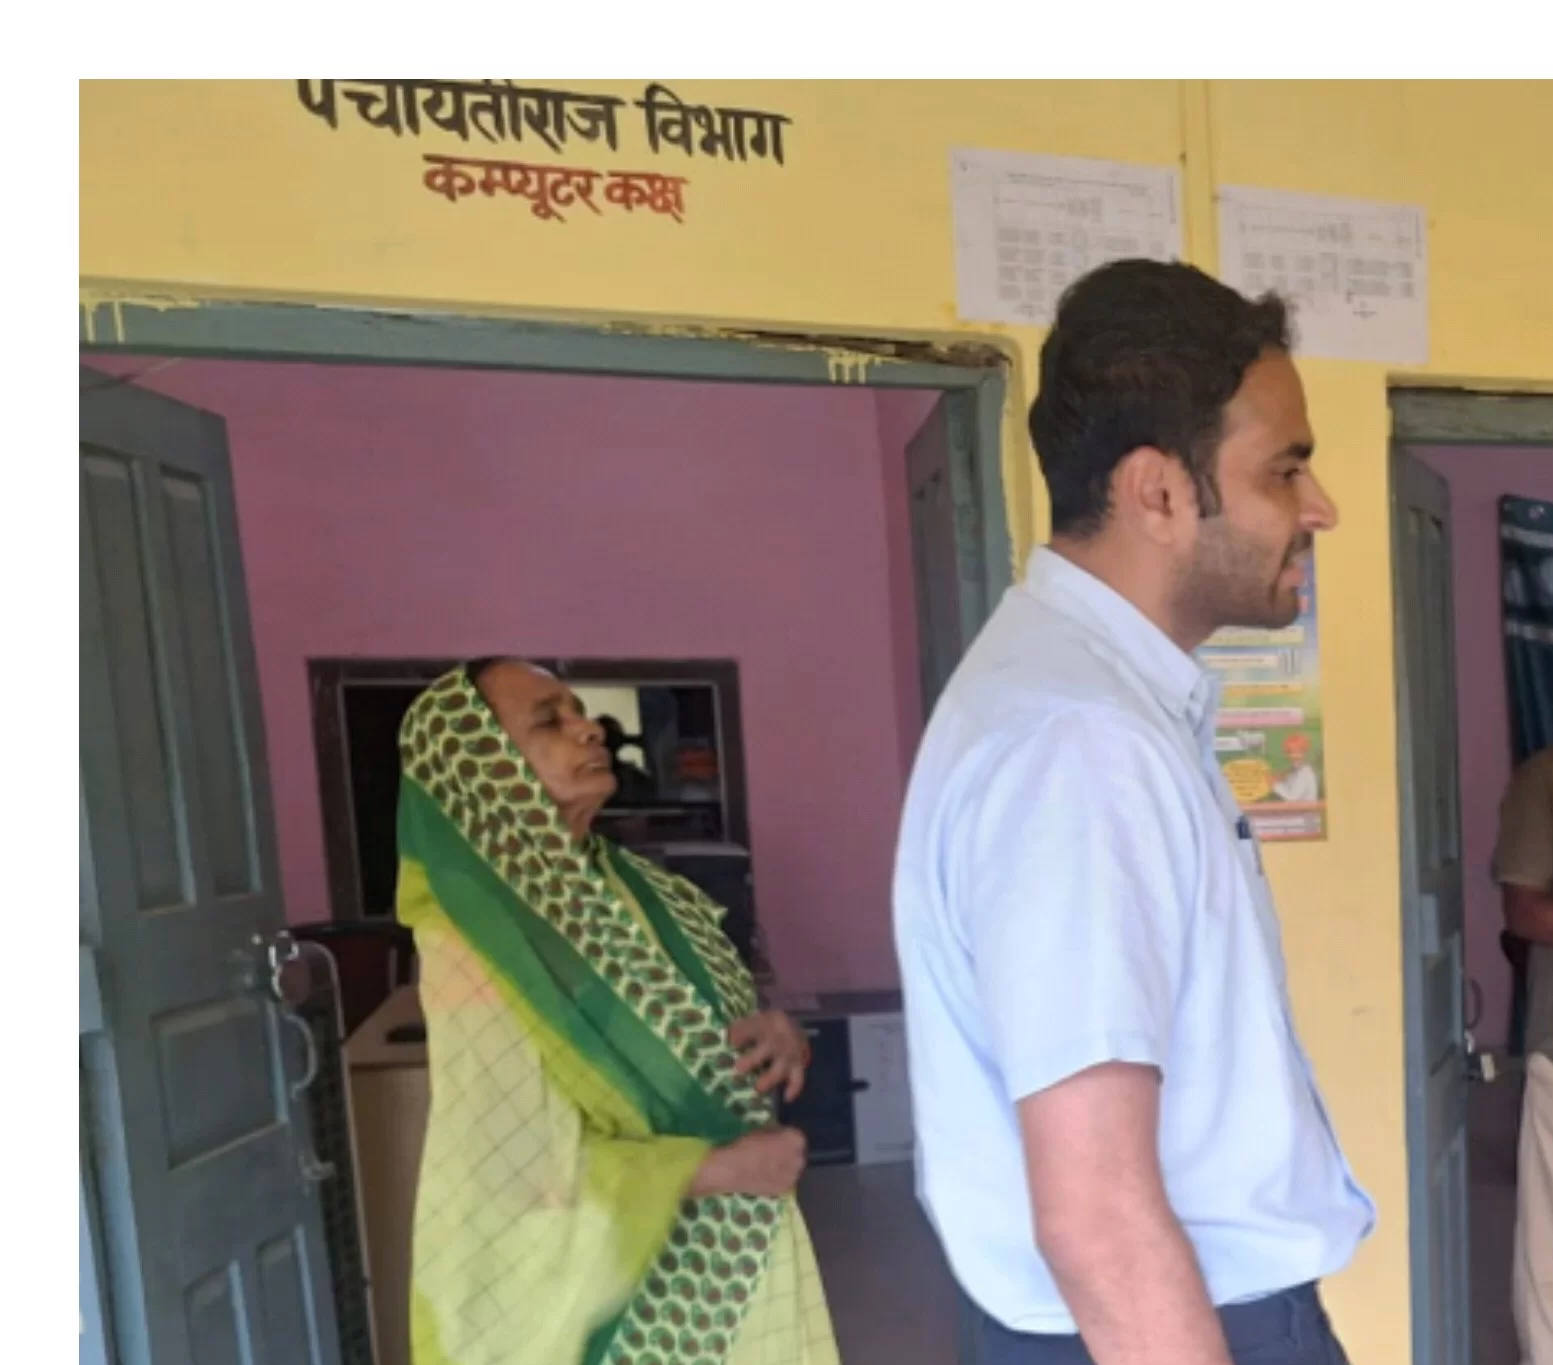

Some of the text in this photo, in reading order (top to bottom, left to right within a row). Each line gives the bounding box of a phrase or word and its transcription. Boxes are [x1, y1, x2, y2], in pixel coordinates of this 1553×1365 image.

[634, 82, 793, 167] विभाग
[422, 153, 691, 223] कम्प्यूटर कक्ष
